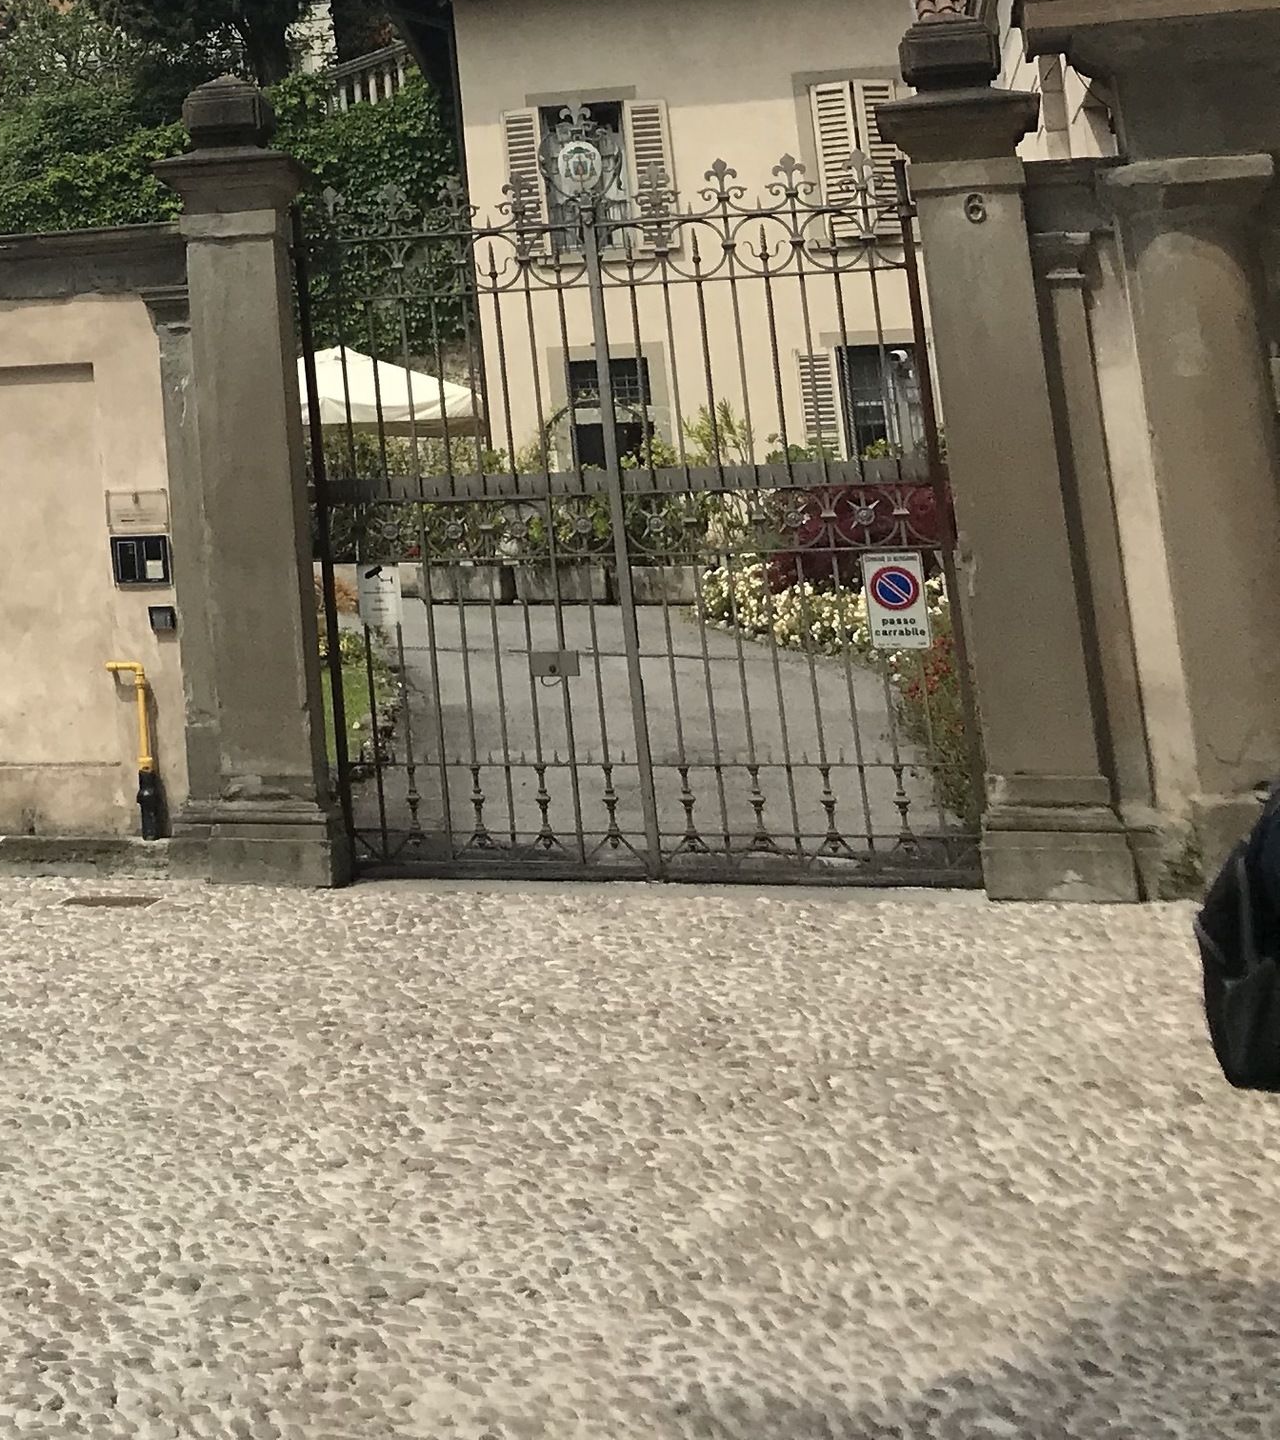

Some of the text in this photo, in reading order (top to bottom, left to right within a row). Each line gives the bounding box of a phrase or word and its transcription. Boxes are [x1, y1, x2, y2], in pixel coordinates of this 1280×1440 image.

[964, 193, 987, 225] 6
[881, 617, 916, 627] passo
[874, 627, 926, 637] carrabile
